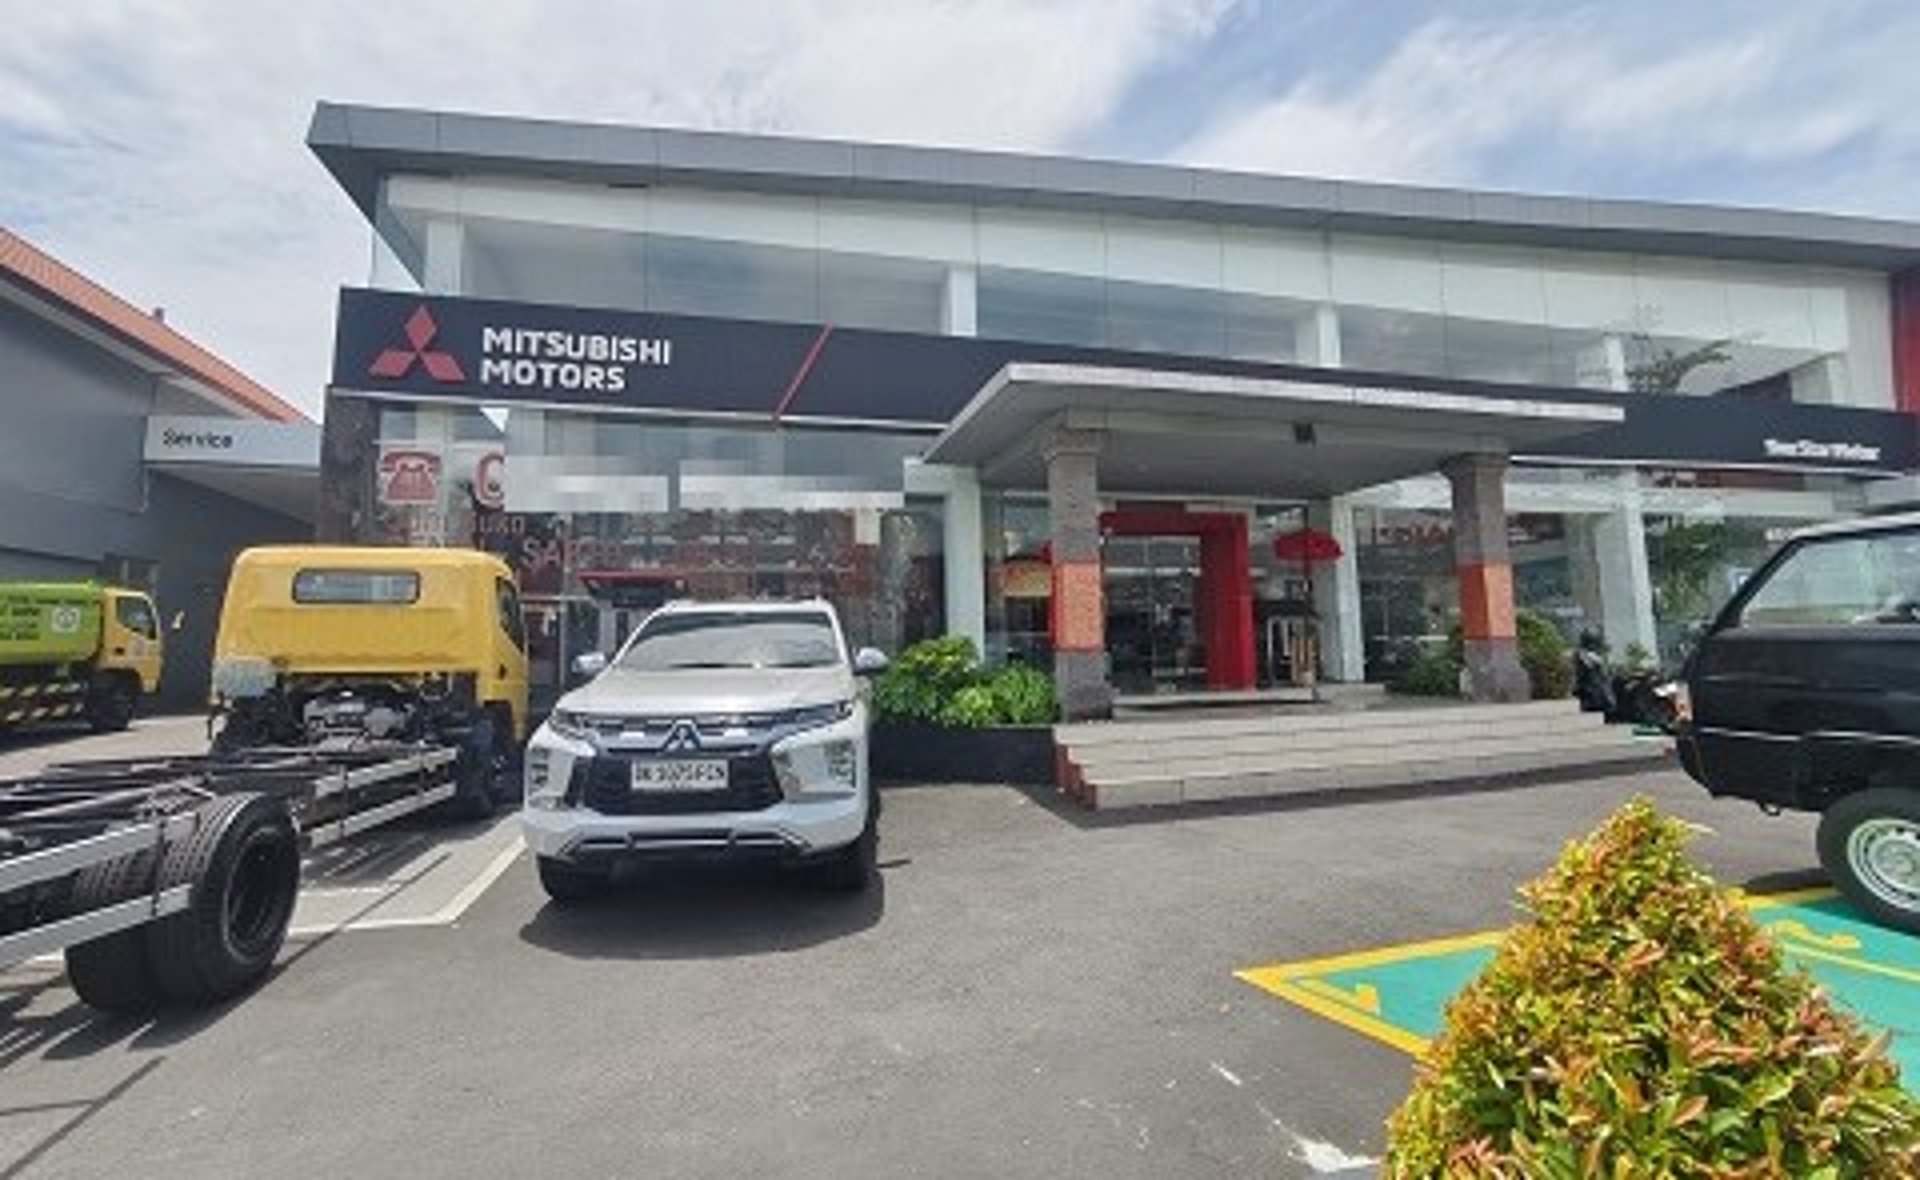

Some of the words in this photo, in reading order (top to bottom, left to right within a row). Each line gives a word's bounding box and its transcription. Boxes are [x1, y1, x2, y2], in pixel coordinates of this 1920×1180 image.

[482, 326, 671, 365] MITSUBISHI
[480, 358, 626, 391] MOTORS
[163, 427, 233, 449] Service
